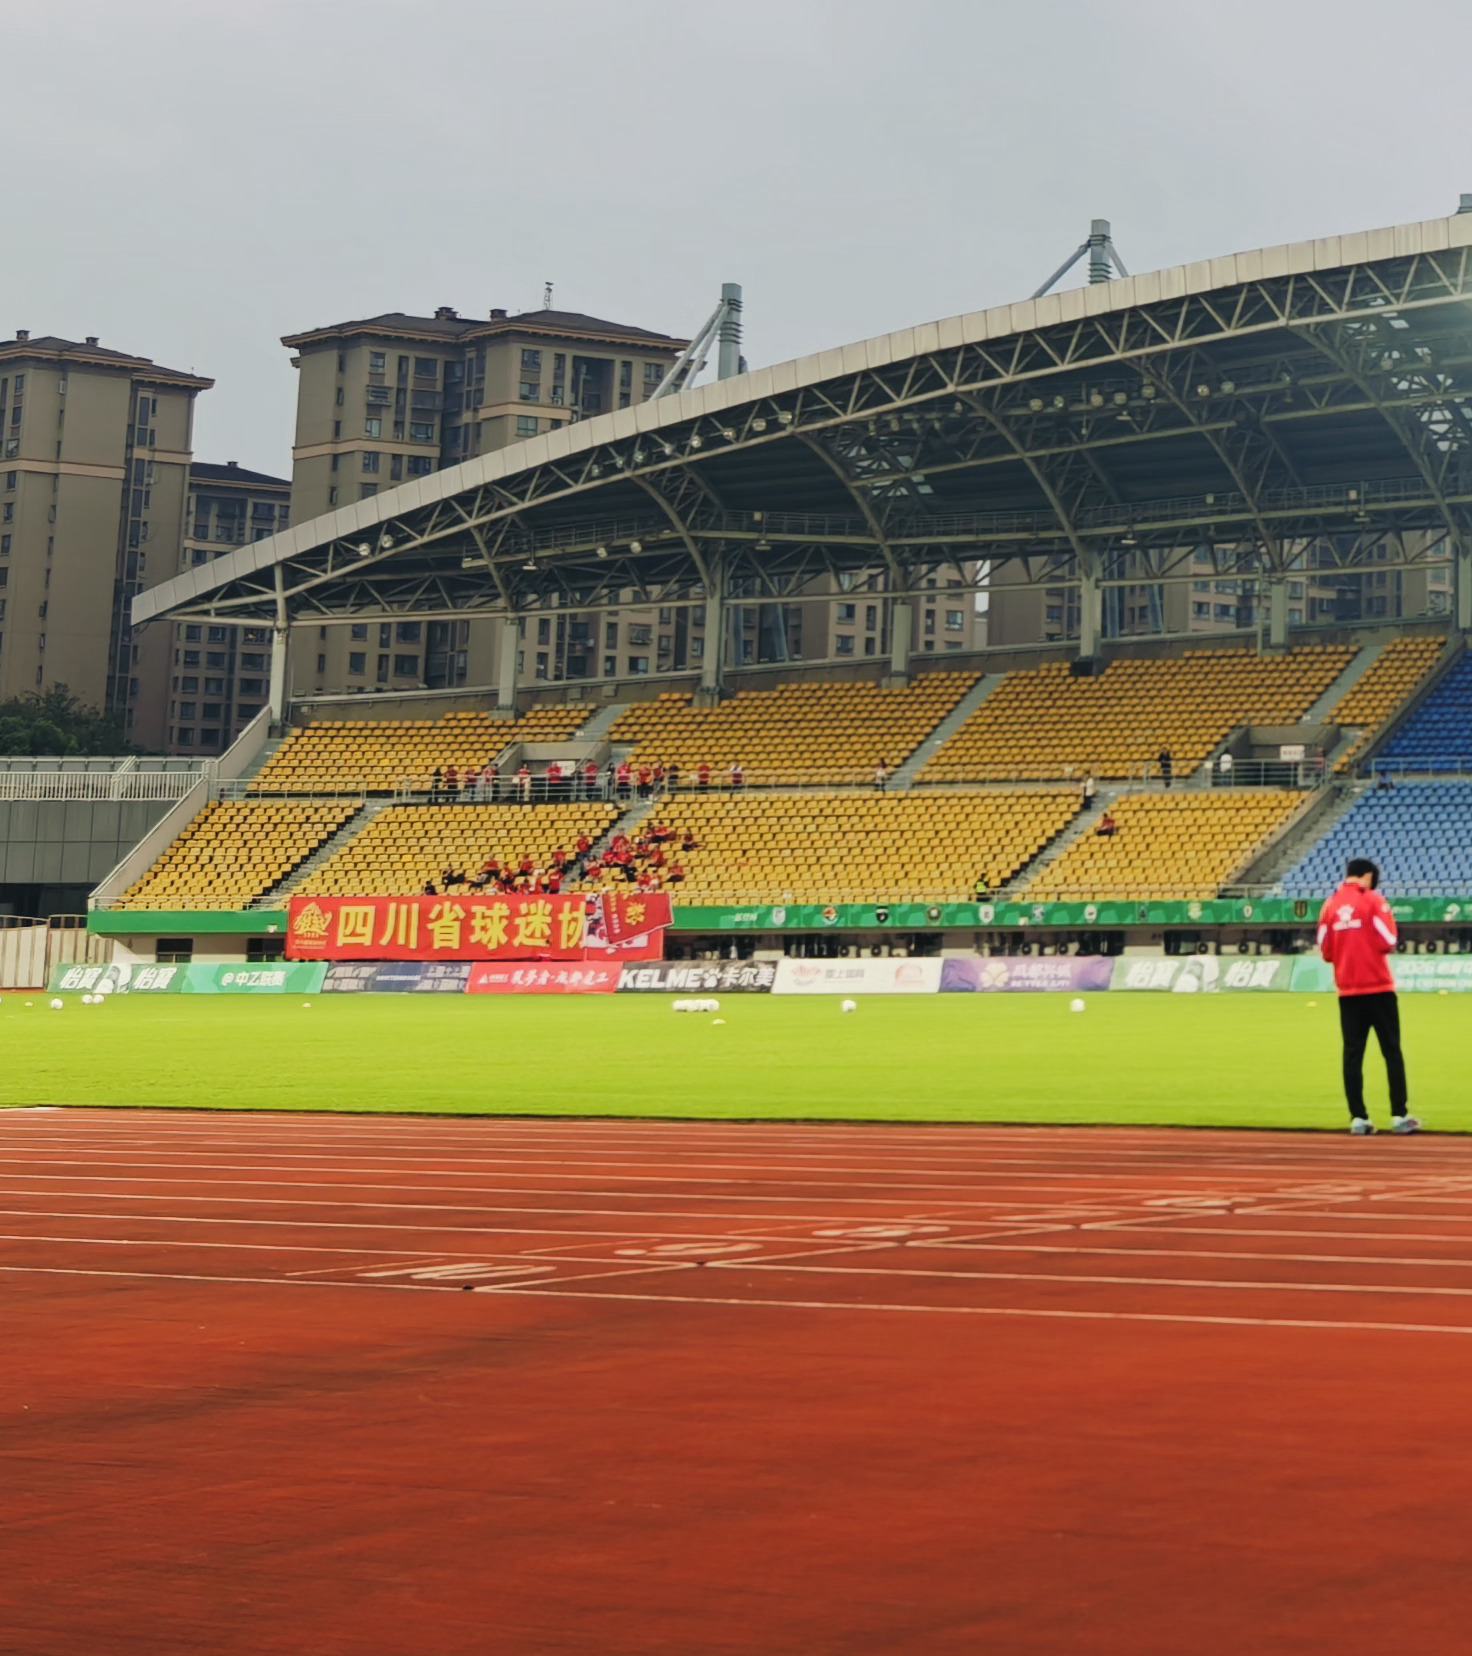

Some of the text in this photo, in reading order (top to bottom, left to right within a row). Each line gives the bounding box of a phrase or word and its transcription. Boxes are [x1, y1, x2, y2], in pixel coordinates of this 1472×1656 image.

[618, 966, 775, 989] KELME 卡尔美
